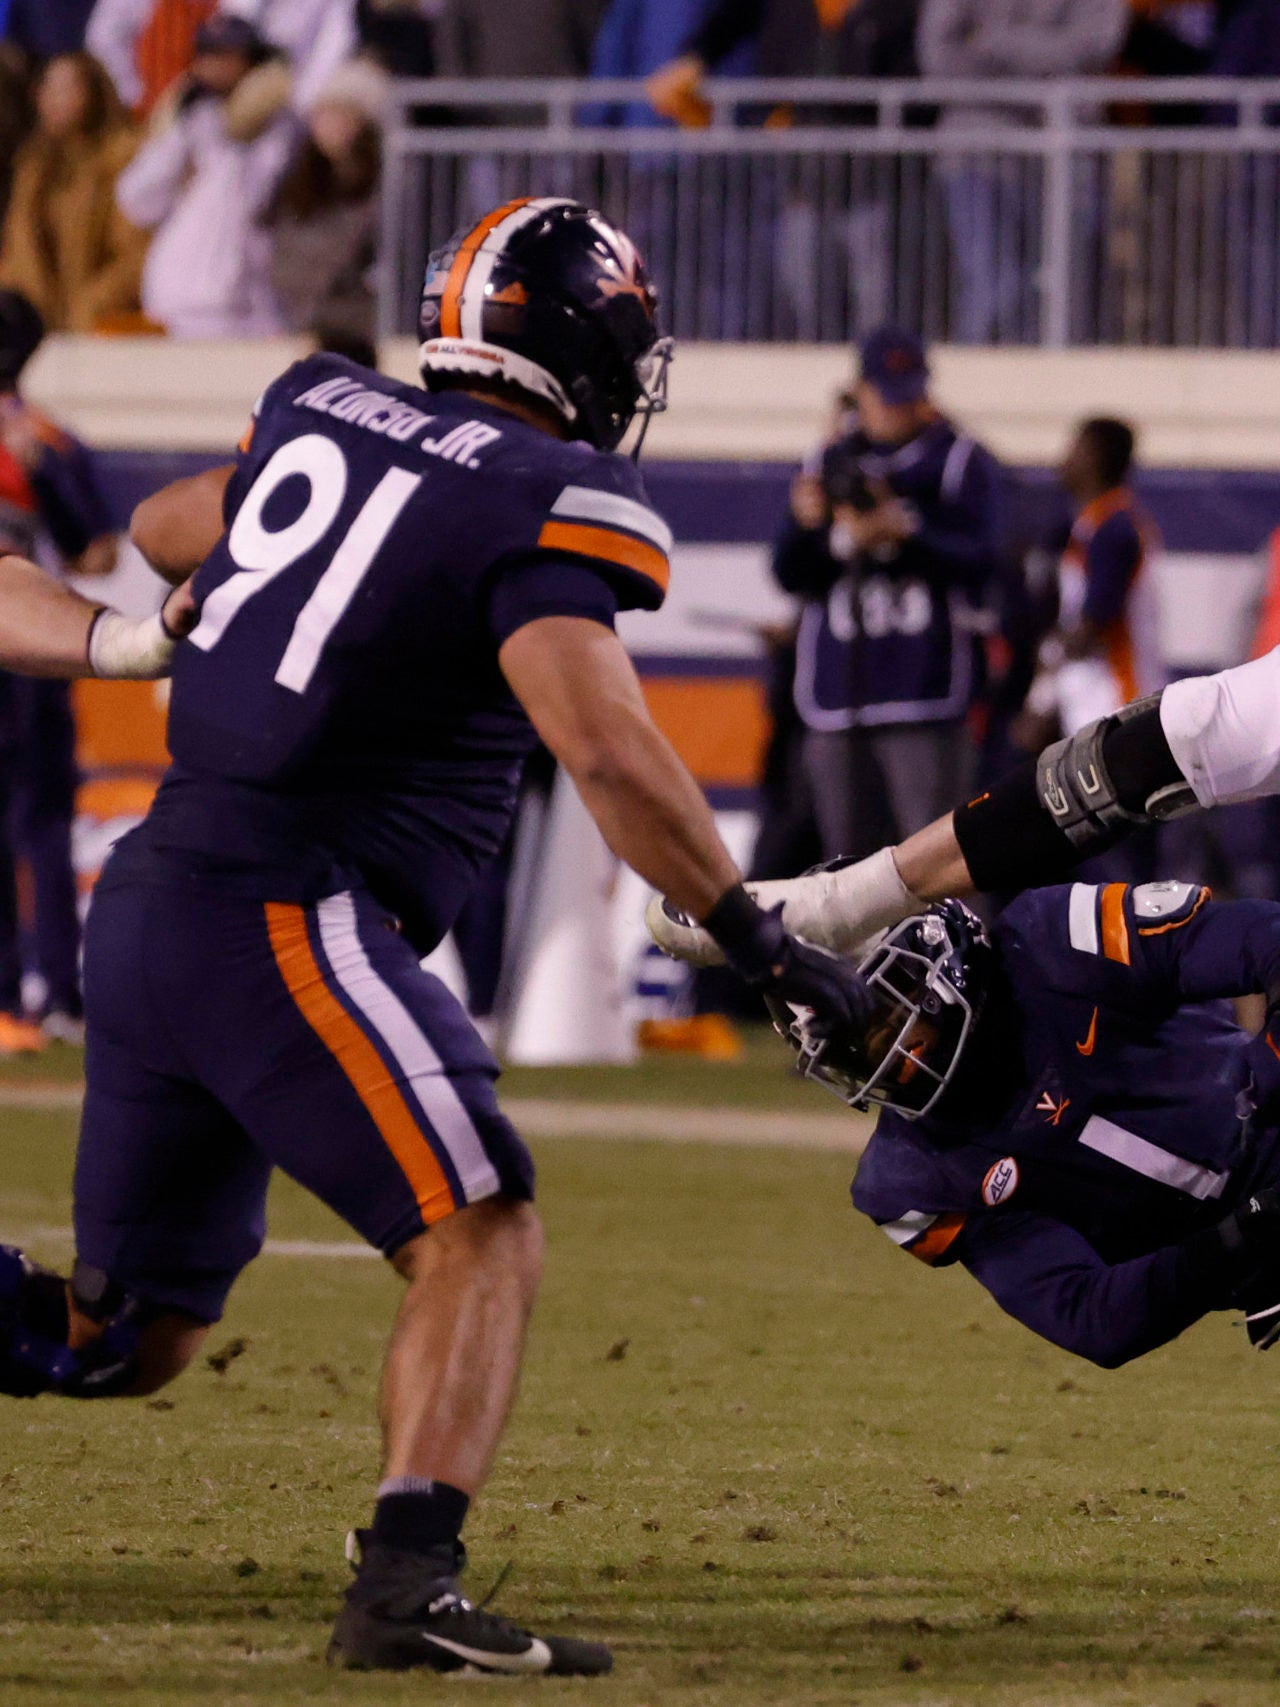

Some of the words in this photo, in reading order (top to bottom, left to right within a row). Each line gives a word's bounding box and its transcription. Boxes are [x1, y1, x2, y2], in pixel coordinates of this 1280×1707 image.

[292, 376, 437, 442] ALONSO
[421, 419, 502, 469] JR.
[187, 433, 423, 694] 91
[990, 1162, 1013, 1205] ACC
